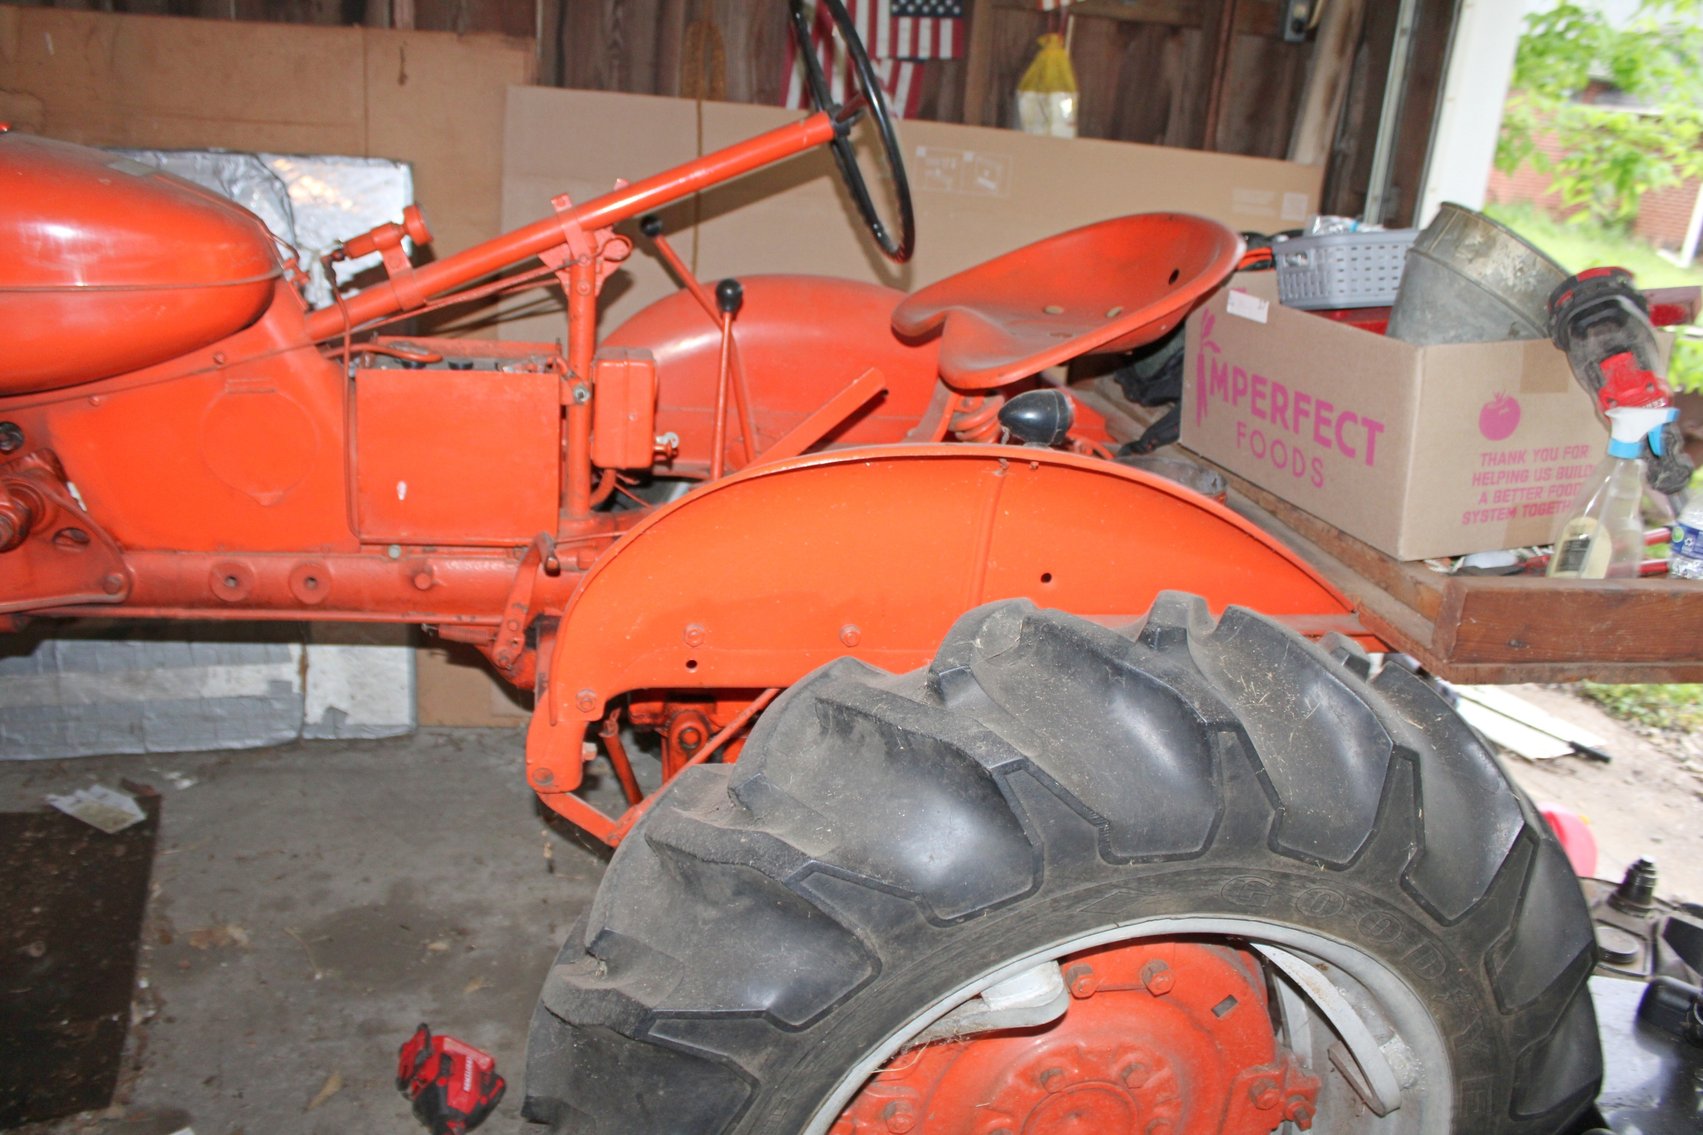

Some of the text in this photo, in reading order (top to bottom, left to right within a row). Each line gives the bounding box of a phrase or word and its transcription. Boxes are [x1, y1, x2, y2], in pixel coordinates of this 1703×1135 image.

[1236, 420, 1325, 489] FOODS
[1481, 444, 1590, 467] THANK YOU FOR
[1472, 463, 1596, 487] HELPING US BUILD
[1478, 491, 1488, 505] A
[1493, 486, 1543, 504] BETTER
[1462, 499, 1572, 526] SYSTEM TOGETH
